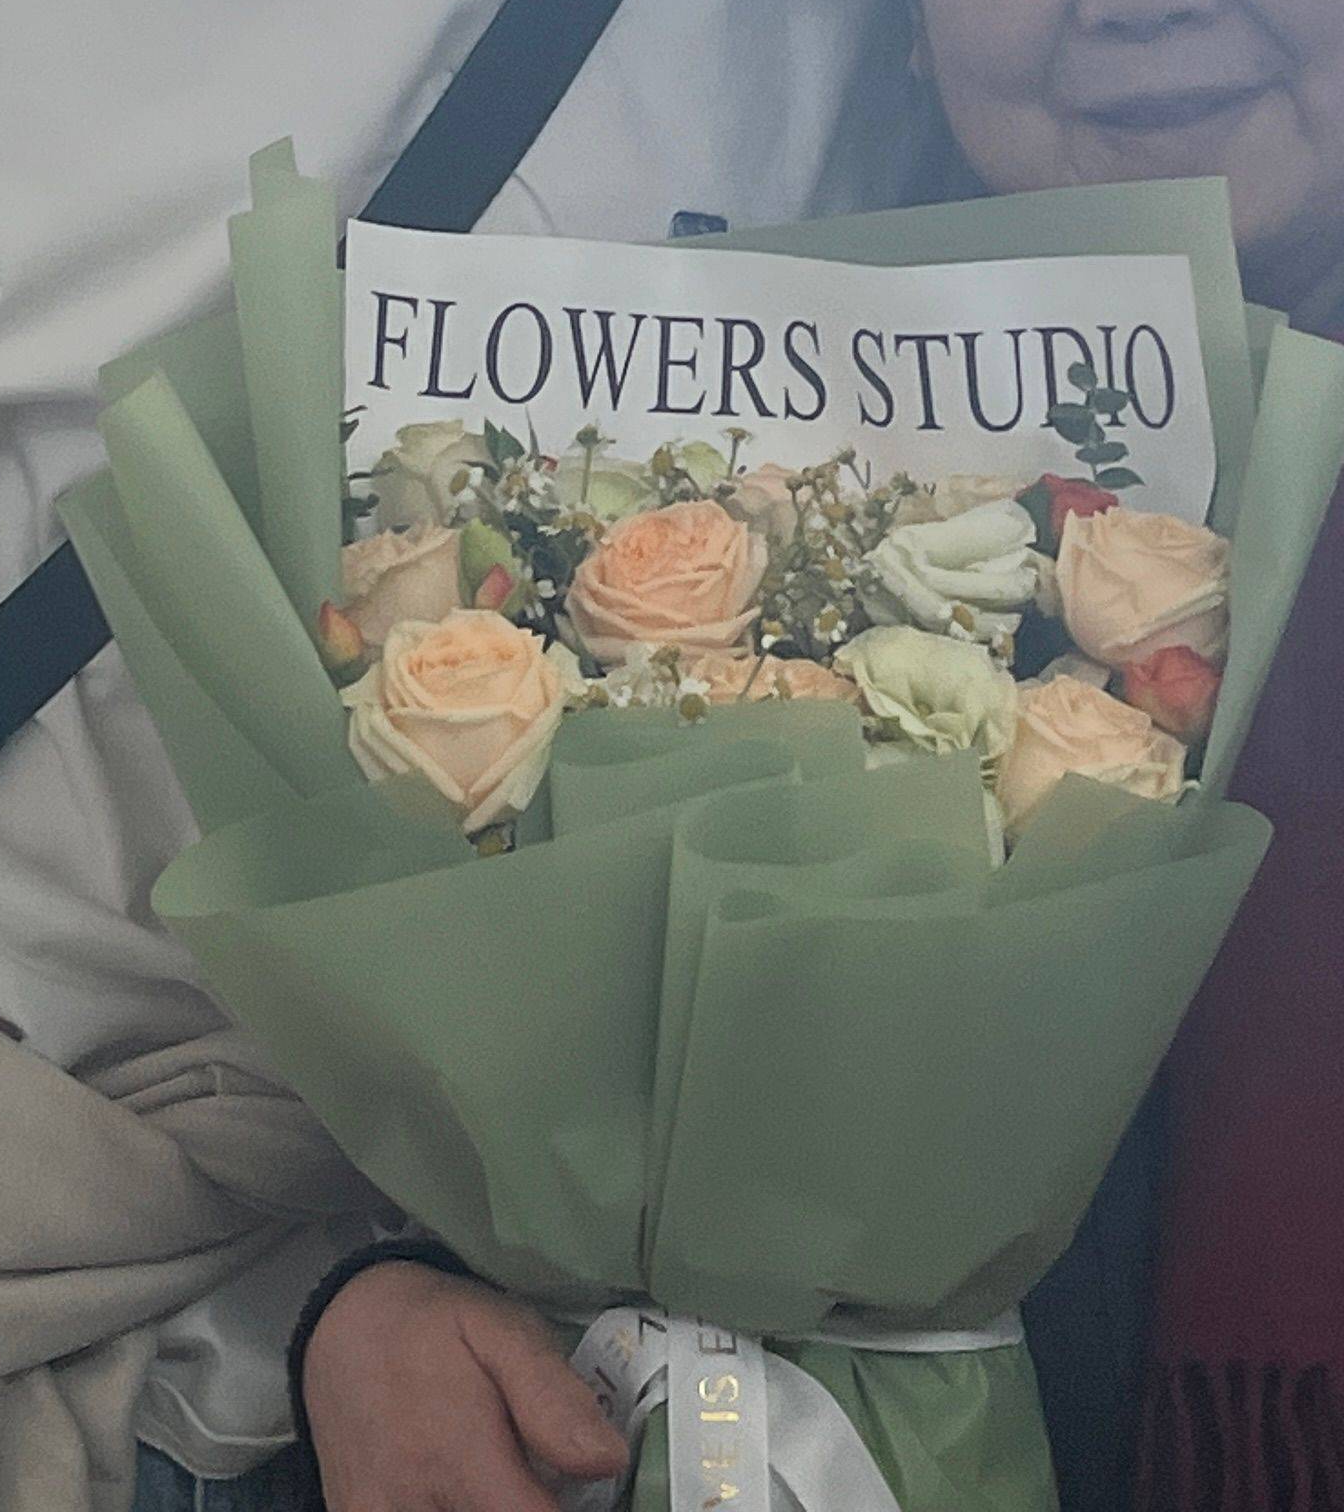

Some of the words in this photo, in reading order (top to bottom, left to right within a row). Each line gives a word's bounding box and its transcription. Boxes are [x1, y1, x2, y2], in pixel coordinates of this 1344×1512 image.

[367, 290, 827, 422] FLOWERS
[851, 324, 1175, 431] STUDIO
[698, 1374, 740, 1422] IS
